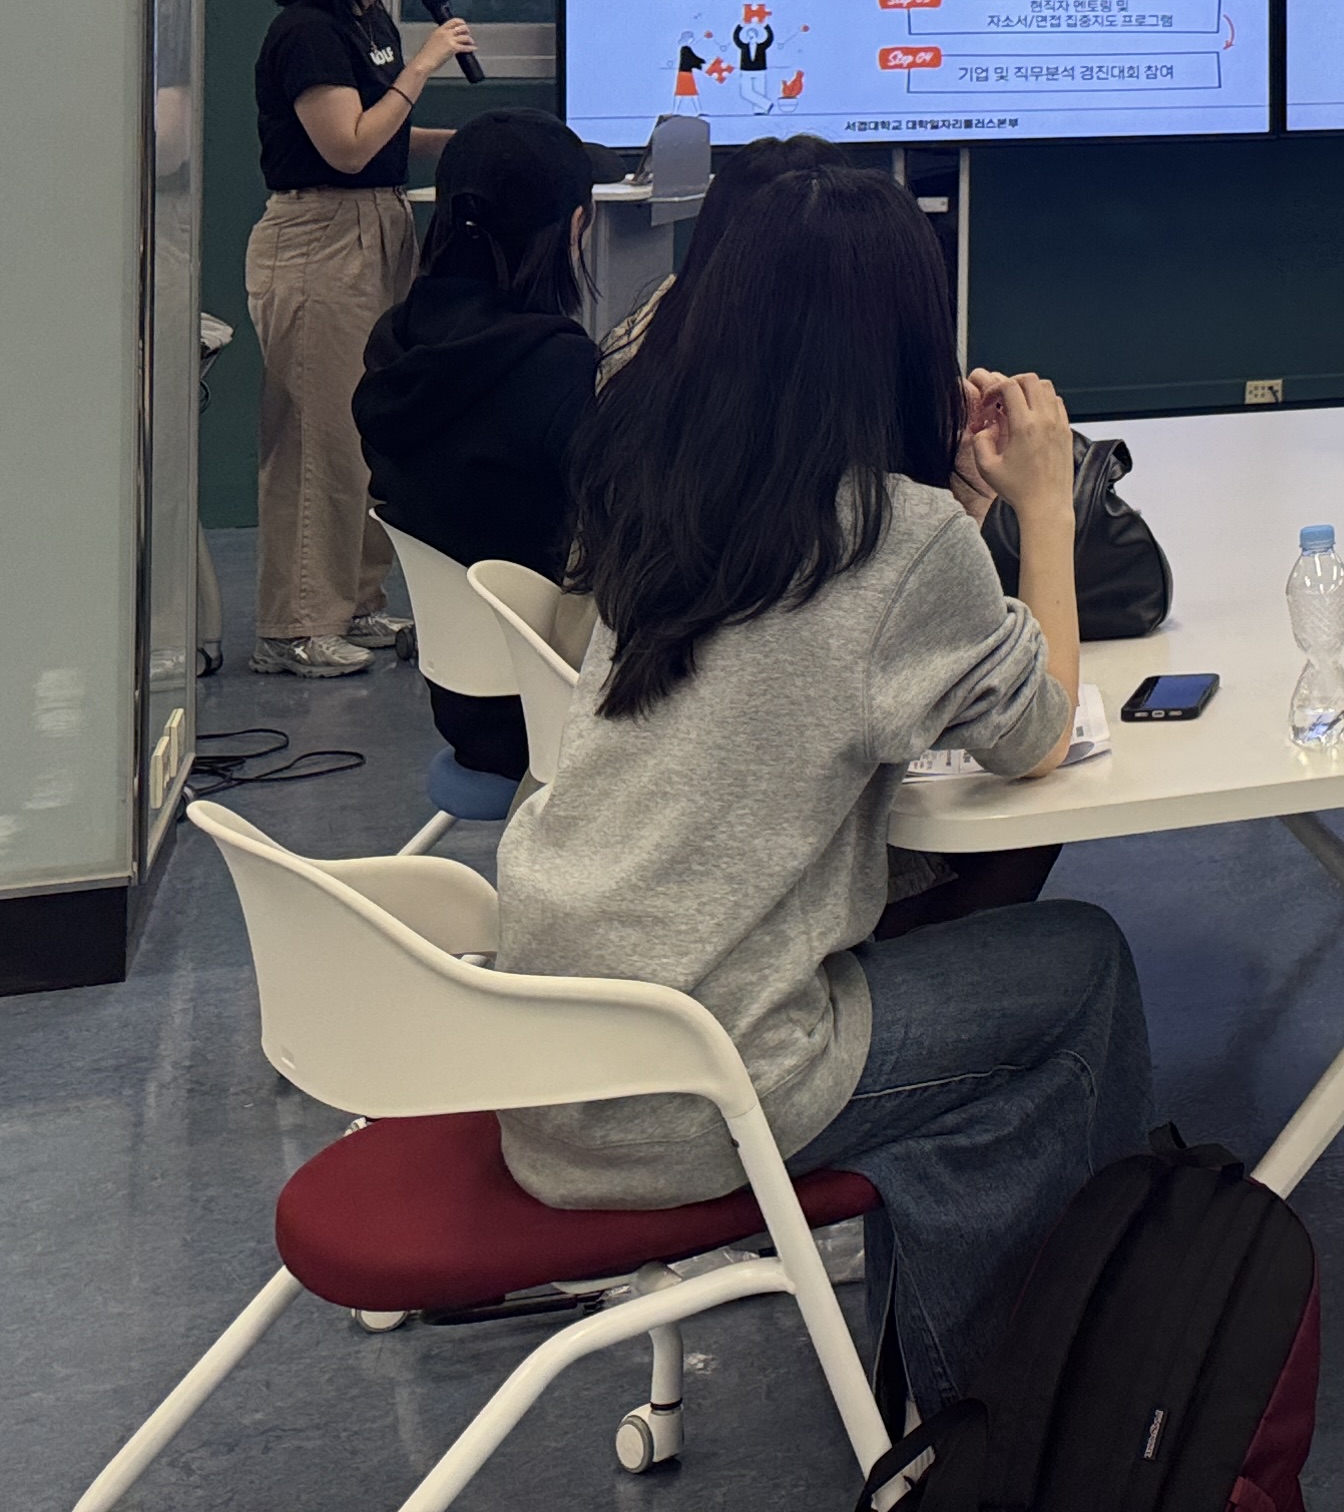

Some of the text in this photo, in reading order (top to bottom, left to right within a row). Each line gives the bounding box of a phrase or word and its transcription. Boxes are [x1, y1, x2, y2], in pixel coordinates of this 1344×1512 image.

[1030, 0, 1070, 14] 현직자
[1115, 0, 1129, 13] 및
[1120, 14, 1174, 28] 프로그램
[887, 49, 933, 67] Step 04
[958, 64, 1174, 83] 기업 및 직무분석 경진대회 참여
